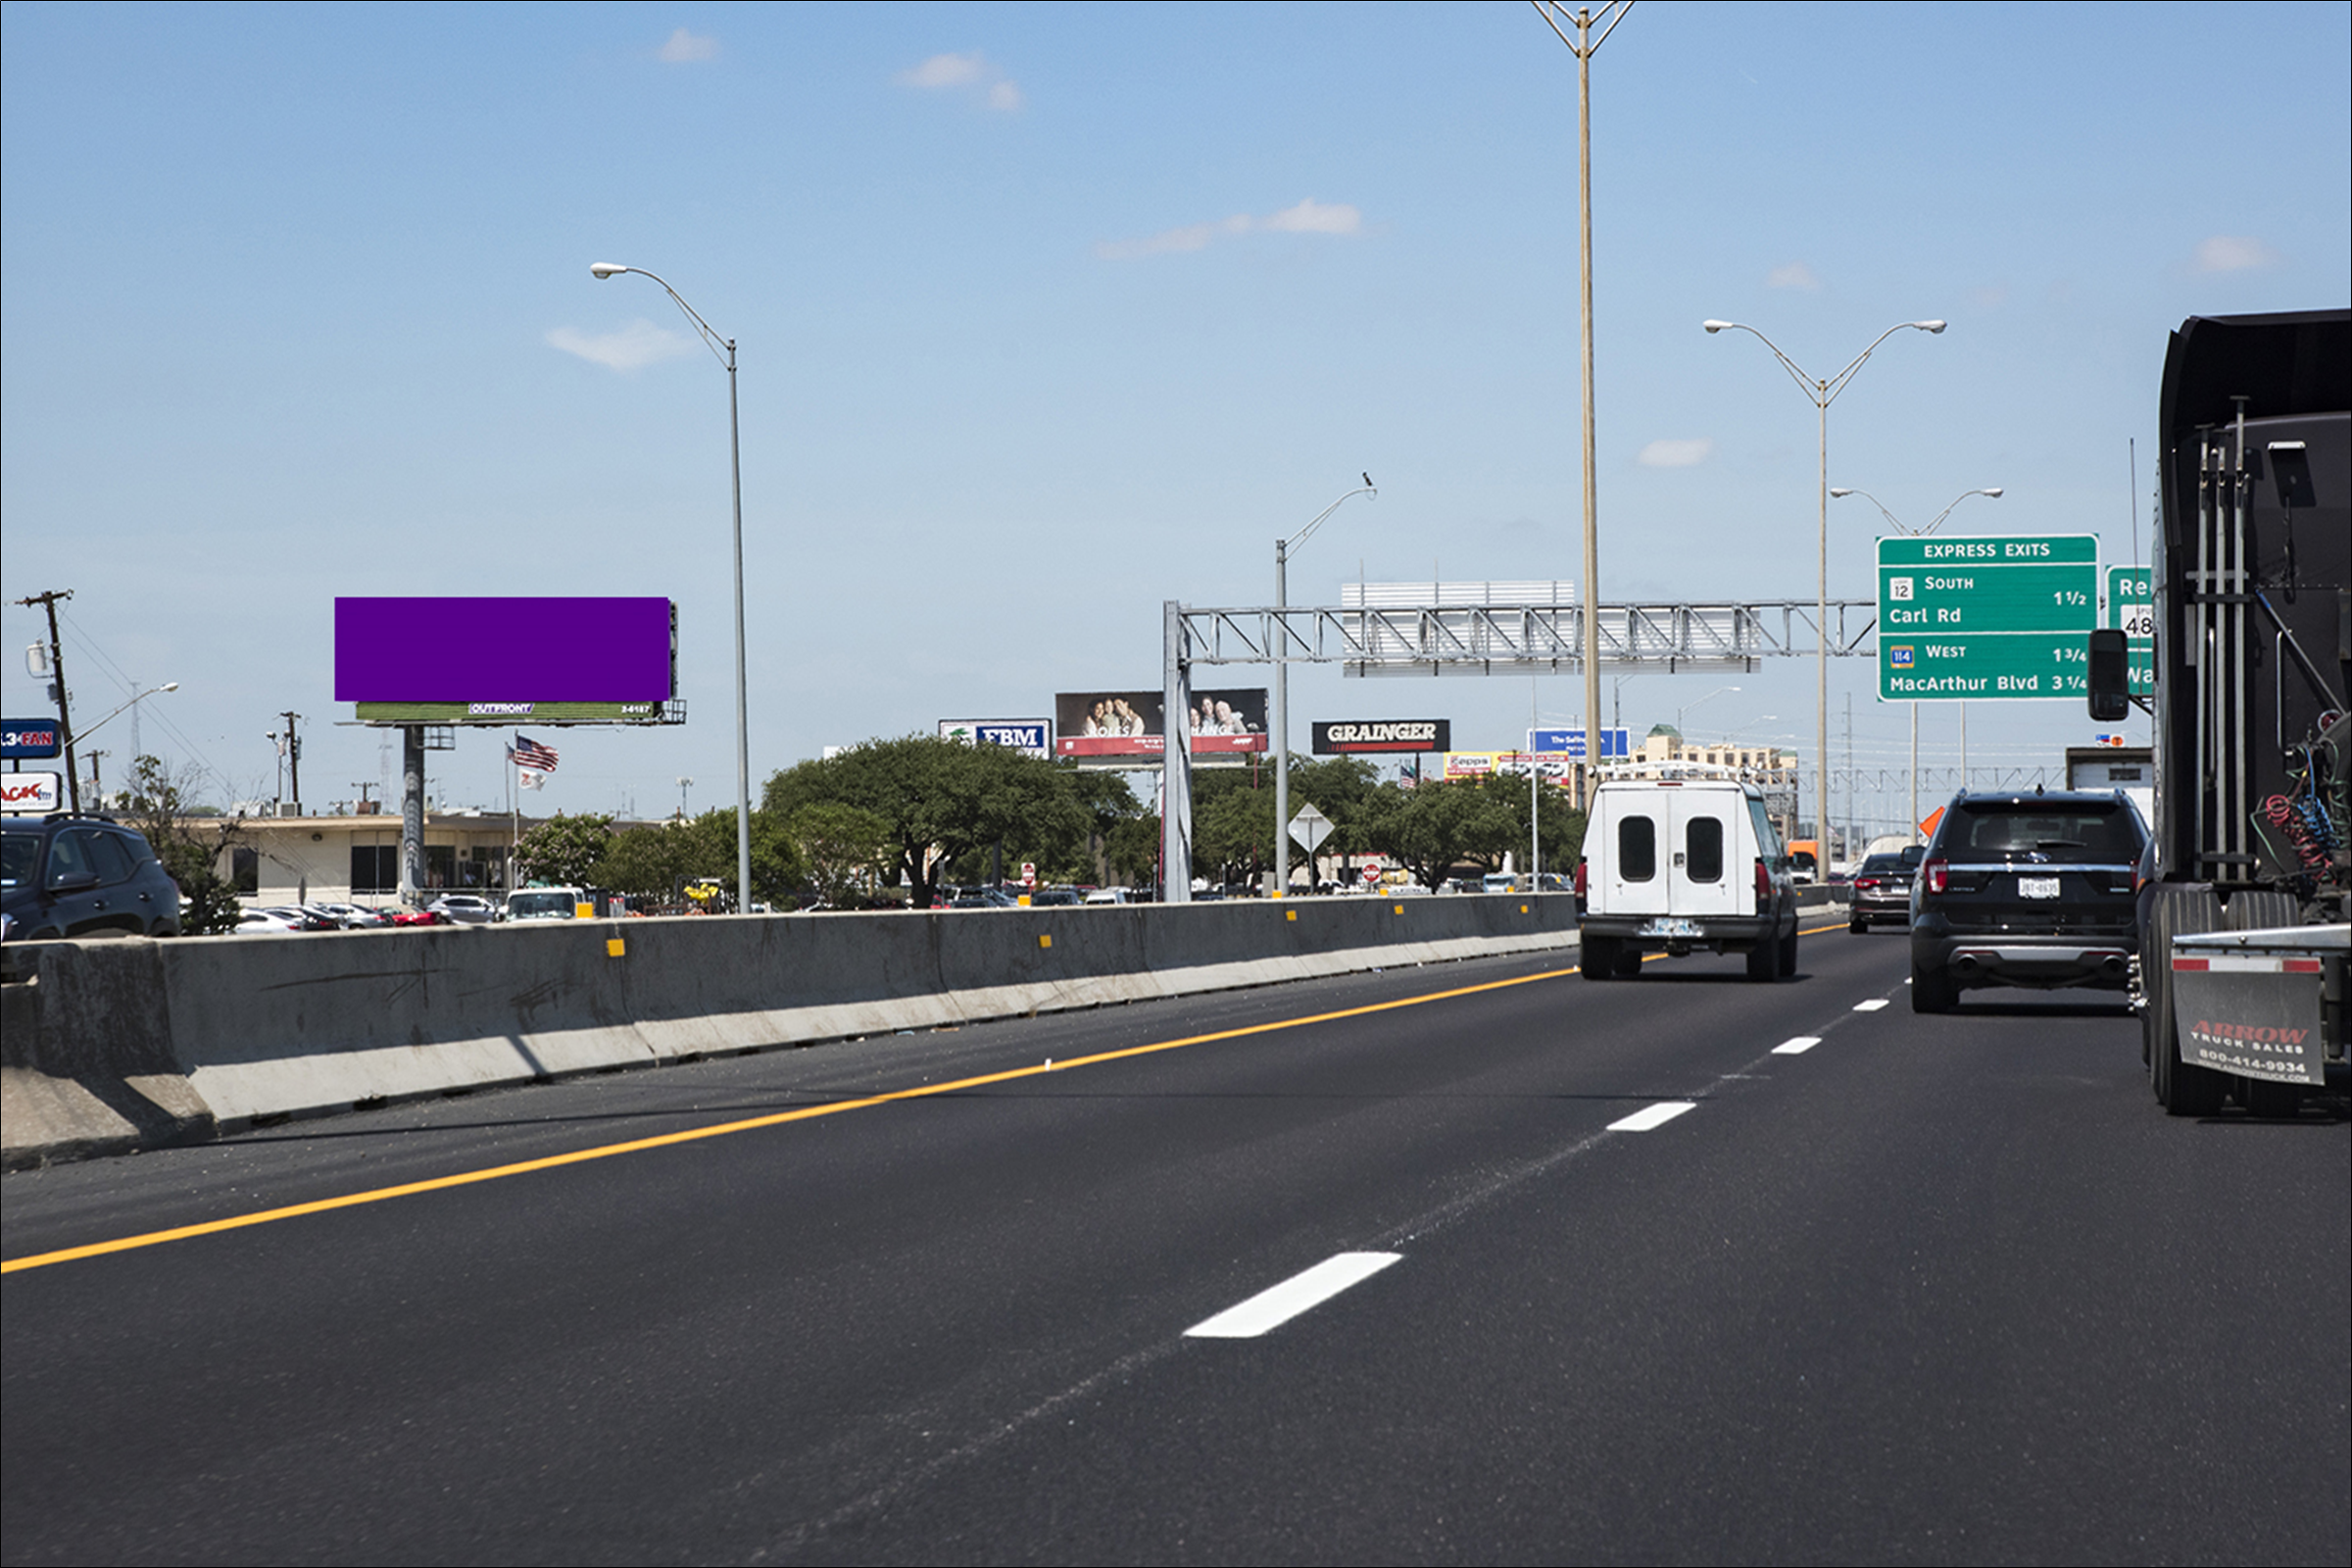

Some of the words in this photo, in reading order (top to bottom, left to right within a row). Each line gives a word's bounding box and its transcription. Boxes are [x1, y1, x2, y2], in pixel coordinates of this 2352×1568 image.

[1924, 544, 1996, 558] EXPRESS
[2005, 542, 2050, 557] EXITS
[1894, 585, 1908, 598] 12
[2120, 578, 2152, 596] Re
[1889, 608, 1928, 623] Carl
[1937, 608, 1961, 622] Rd
[1890, 676, 1987, 692] MacArthur
[1997, 674, 2038, 691] Blvd
[470, 703, 532, 714] OUTFRONT
[21, 731, 53, 746] FAN
[1327, 723, 1437, 742] GRAINGER
[2192, 1020, 2309, 1045] ARROW
[2190, 1032, 2244, 1049] TRUCK
[2252, 1042, 2304, 1054] SALES
[2199, 1049, 2306, 1074] 800-414-9934
